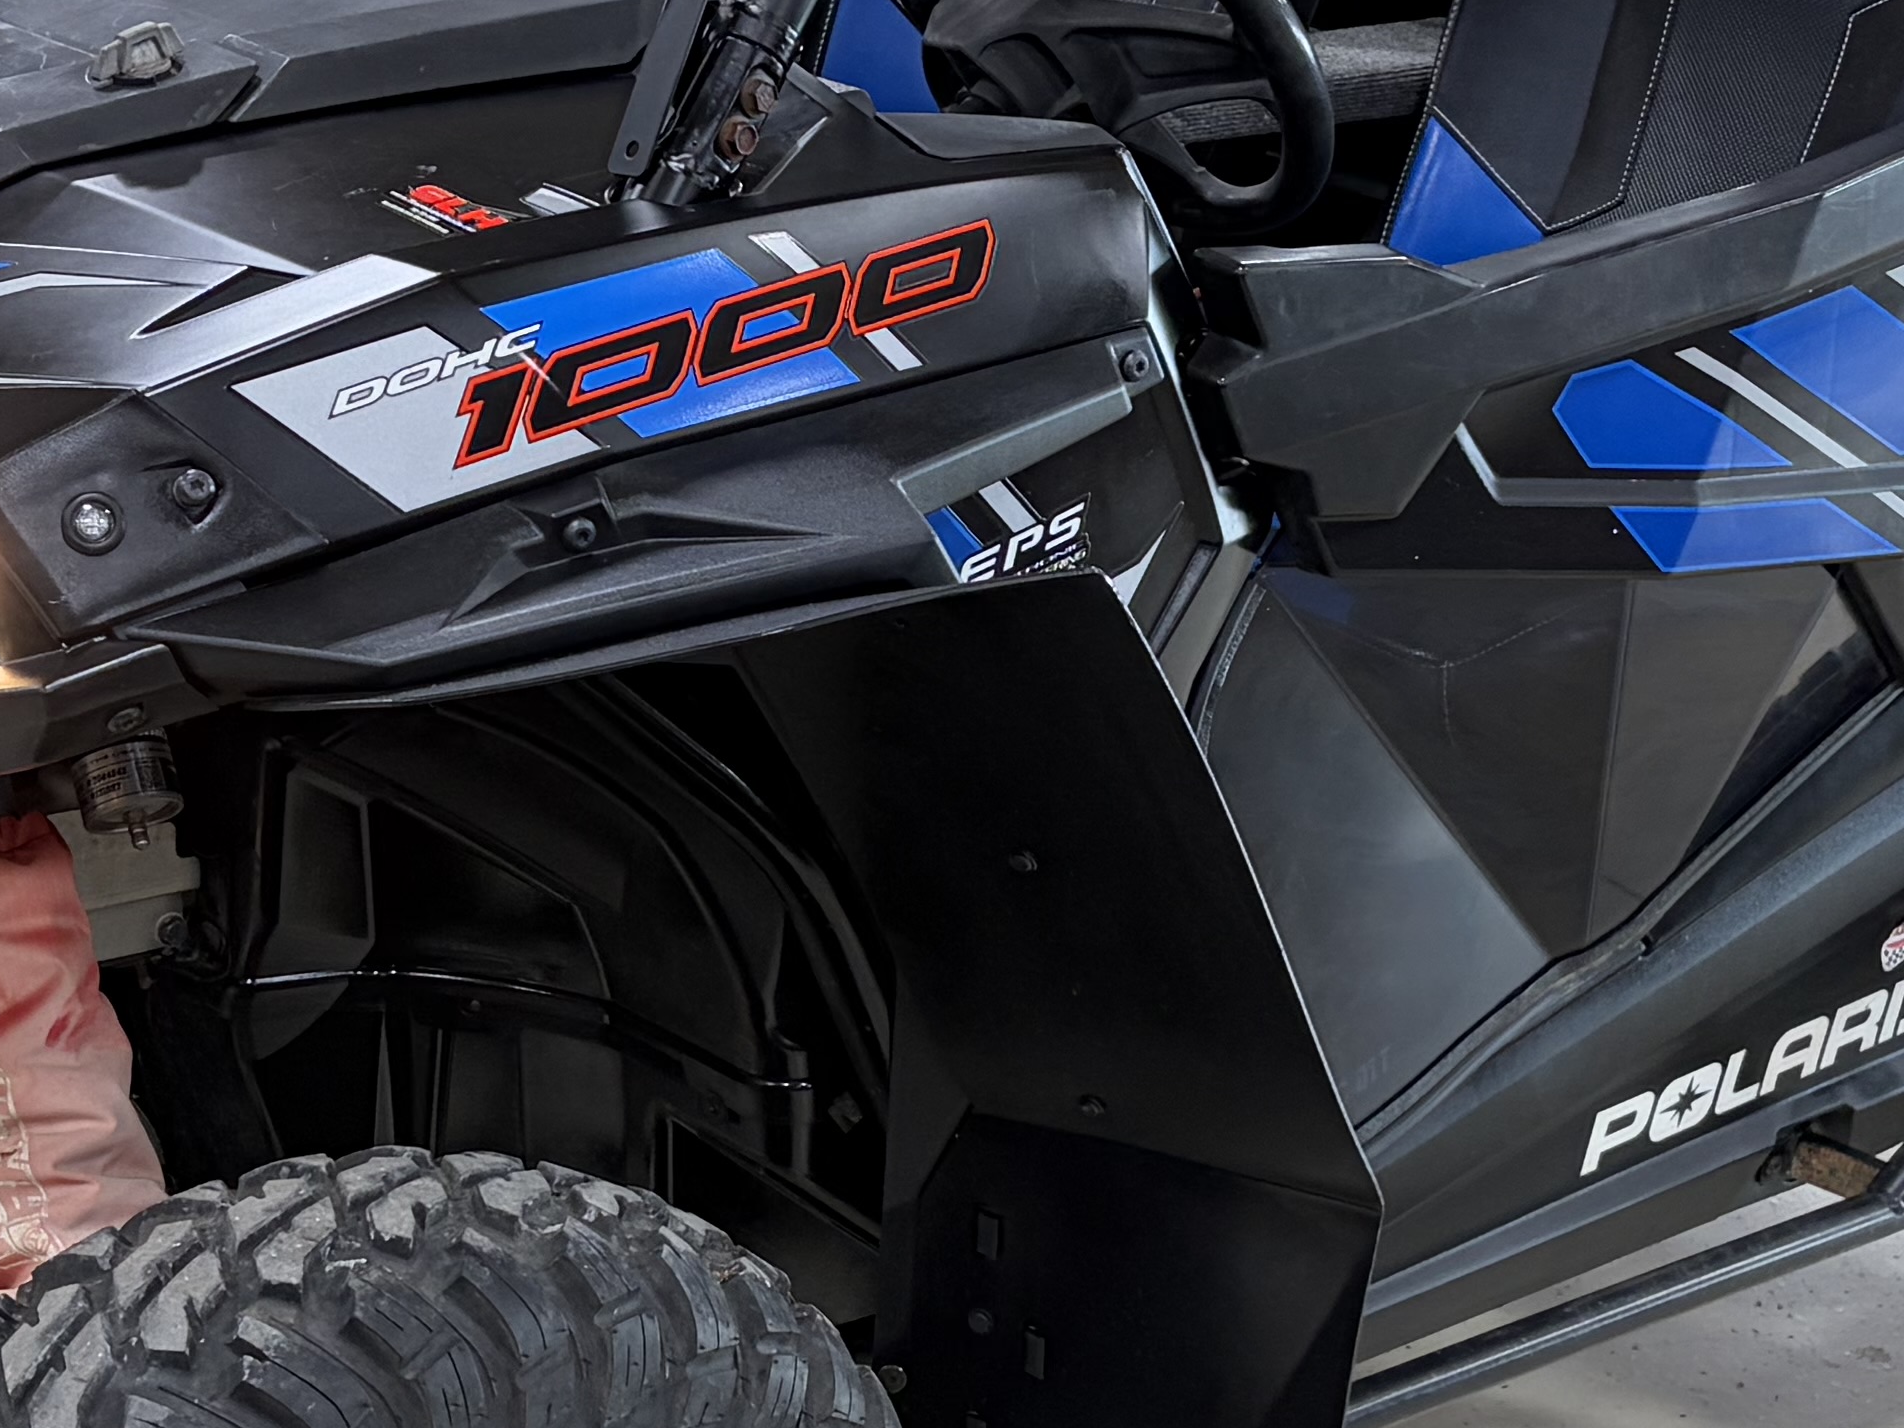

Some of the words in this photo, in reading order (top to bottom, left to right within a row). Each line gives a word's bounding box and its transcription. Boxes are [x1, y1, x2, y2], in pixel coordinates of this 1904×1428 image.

[328, 324, 542, 419] DOHC
[452, 218, 998, 470] 1000
[960, 502, 1085, 584] EPS
